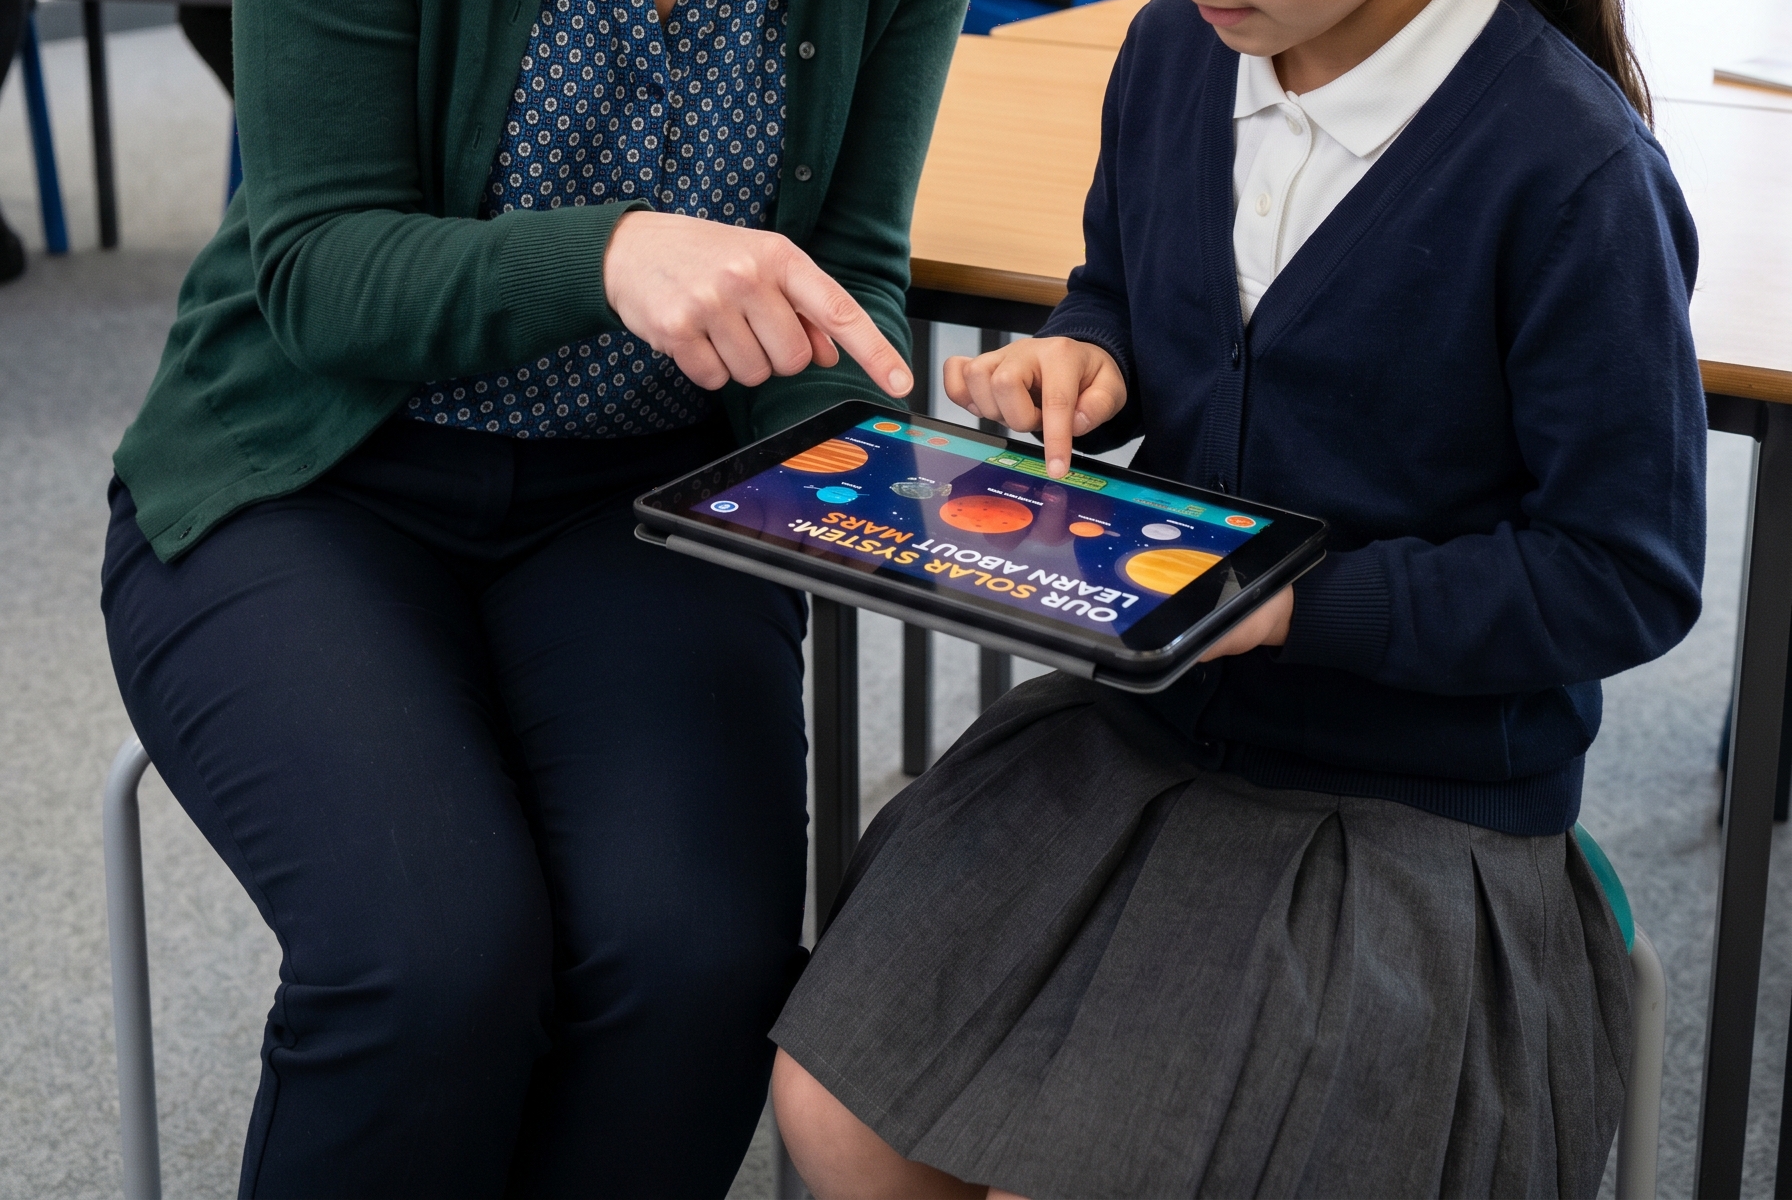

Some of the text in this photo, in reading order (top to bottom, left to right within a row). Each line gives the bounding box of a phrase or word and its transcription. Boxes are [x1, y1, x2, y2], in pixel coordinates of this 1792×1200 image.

[788, 518, 1118, 623] OUR SOLAR SYSTEM:
[821, 511, 1140, 609] LEARN ABOUT MARS
